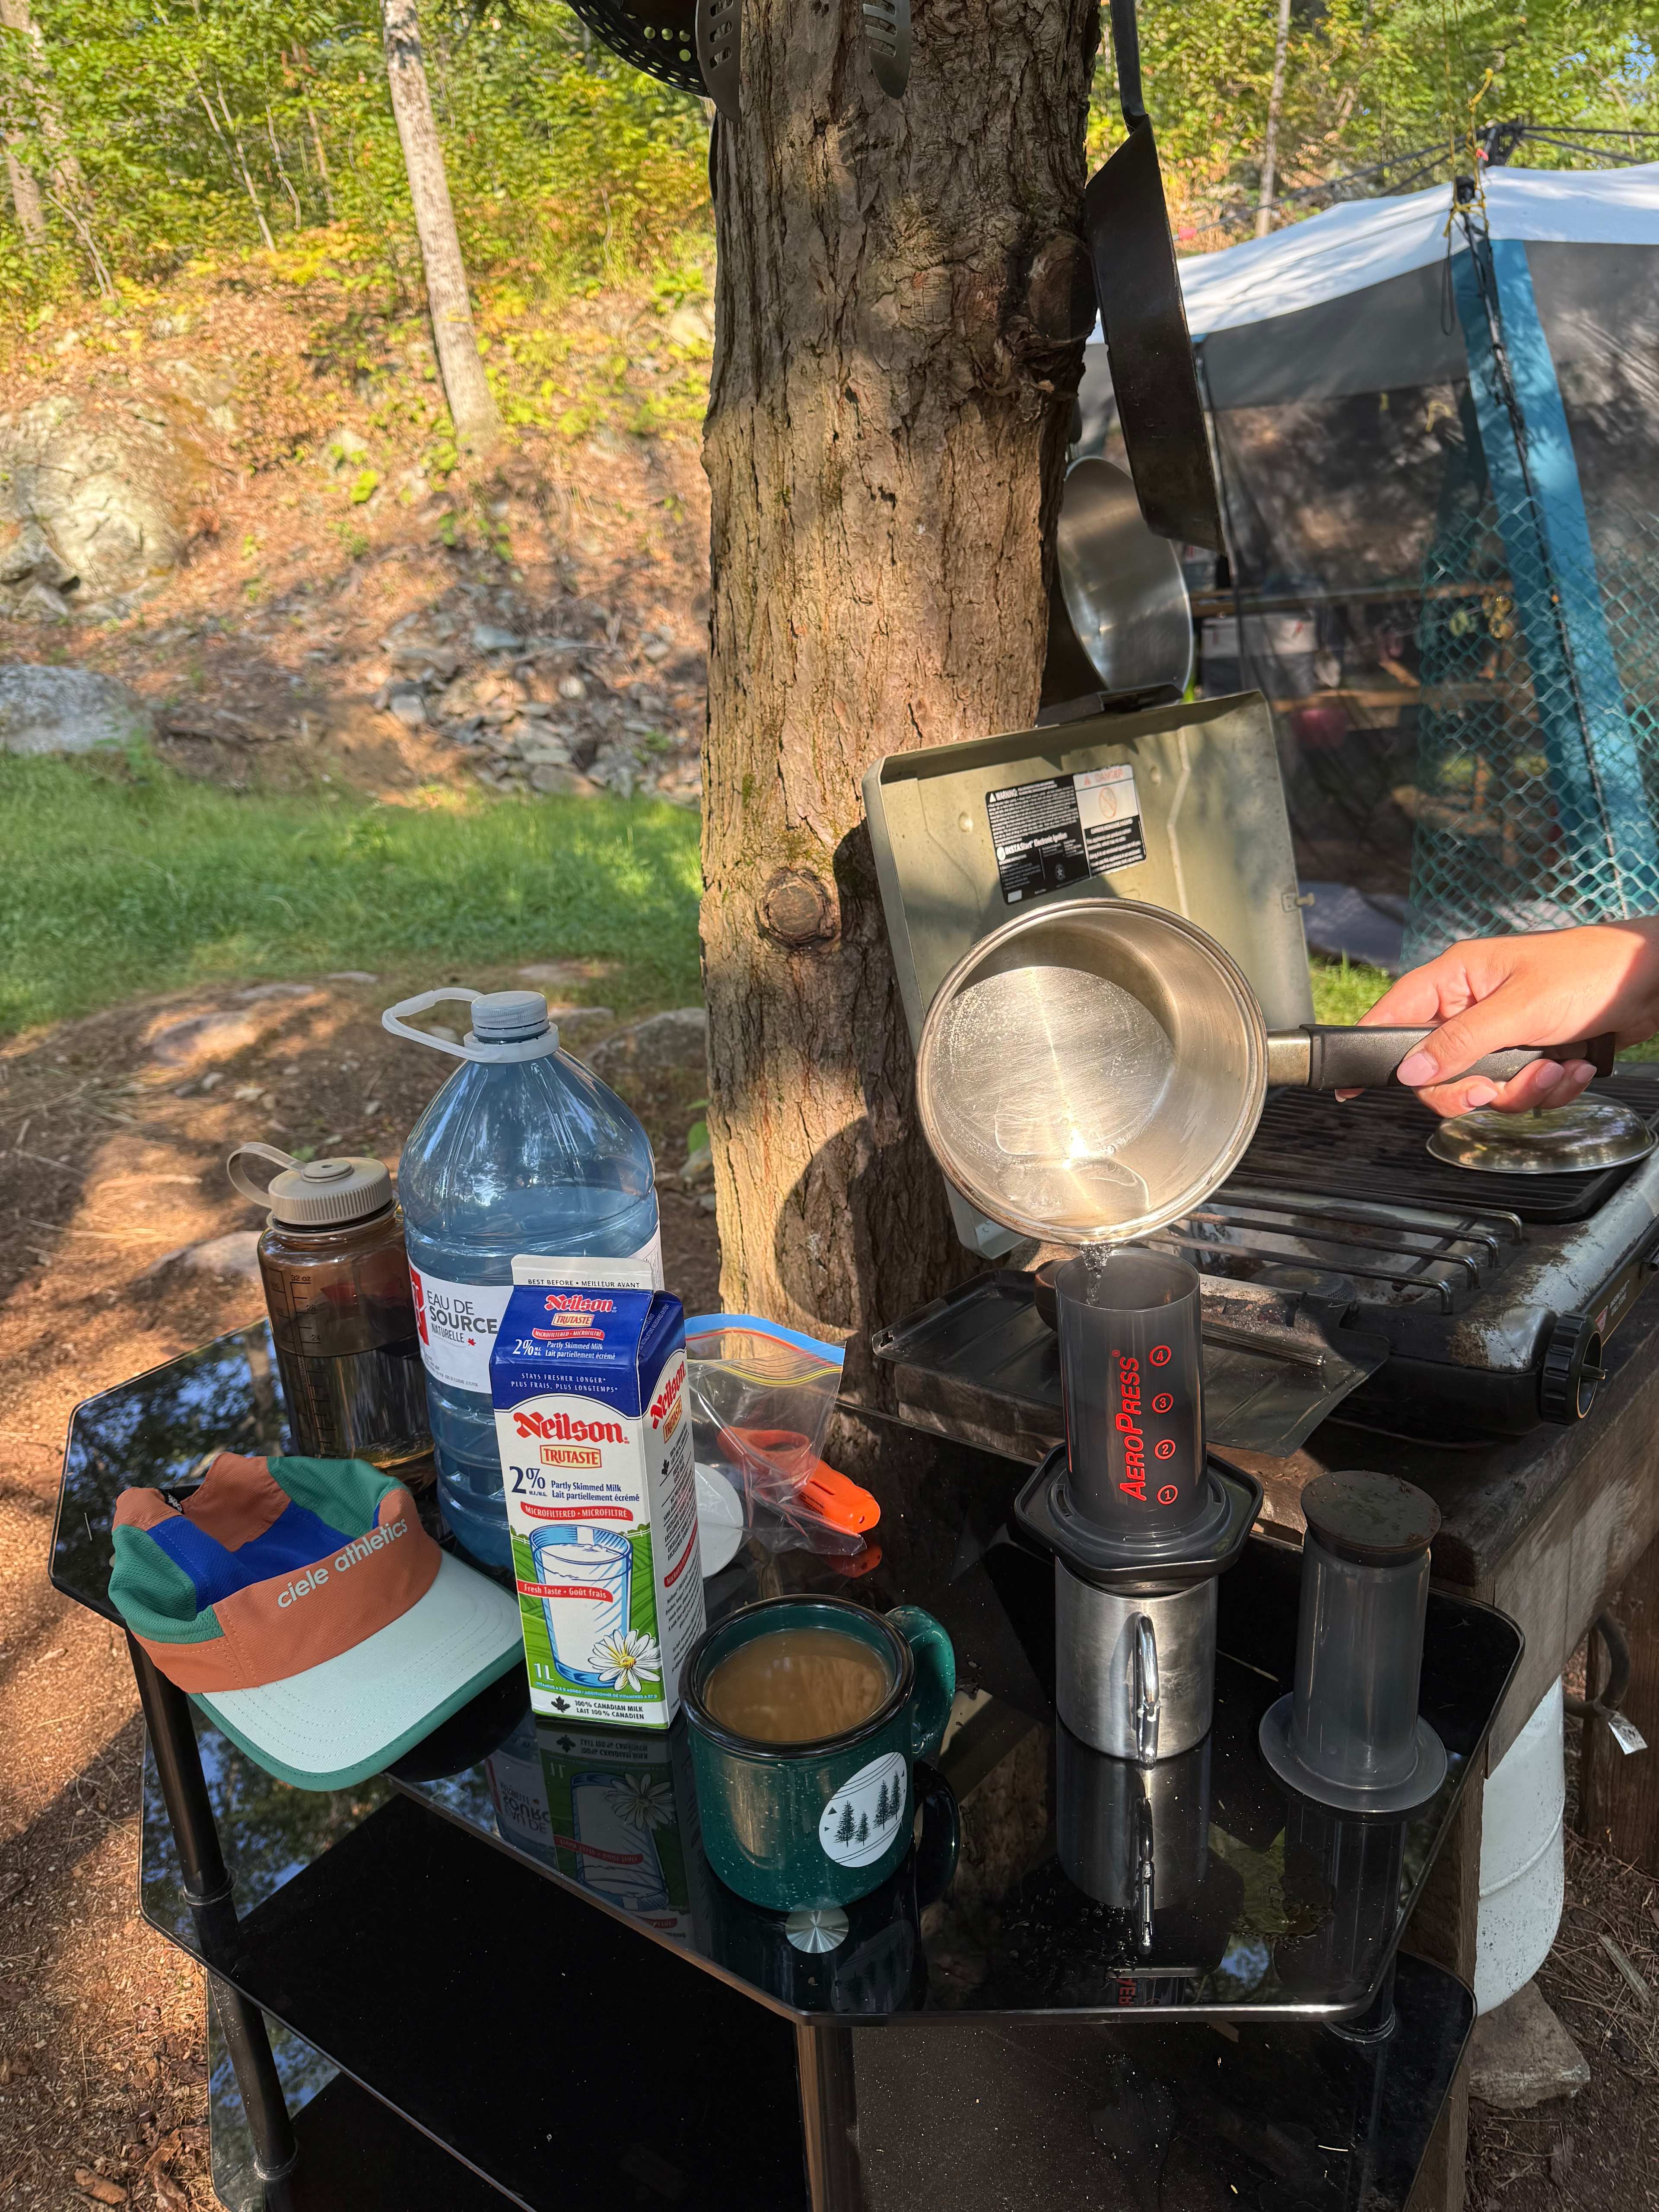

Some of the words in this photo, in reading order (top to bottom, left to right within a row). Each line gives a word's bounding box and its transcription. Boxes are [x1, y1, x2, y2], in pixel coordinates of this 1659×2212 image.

[427, 1290, 449, 1310] EAU
[454, 1300, 474, 1315] DE
[544, 1294, 613, 1312] Neilson
[430, 1306, 498, 1334] SOURCE
[556, 1316, 591, 1325] TRUTASTE
[432, 1323, 464, 1343] NATURELLE
[512, 1339, 533, 1356] 2%
[651, 1361, 686, 1429] Neilson
[513, 1411, 623, 1443] Neilson
[543, 1448, 599, 1465] TRUTASTE
[509, 1466, 545, 1494] 2%
[551, 1481, 571, 1491] Partly
[573, 1482, 604, 1491] Skimmed
[552, 1490, 564, 1498] Lait
[566, 1492, 612, 1501] partiellement
[525, 1505, 575, 1518] MICROFILTERED
[582, 1508, 627, 1518] MICROFILTRÉ
[278, 1568, 329, 1608] ciele
[335, 1519, 407, 1572] athletics
[524, 1584, 541, 1594] Fresh
[588, 1589, 607, 1598] frais
[536, 1681, 555, 1690] VITAMINS
[594, 1703, 626, 1711] CANADIAN
